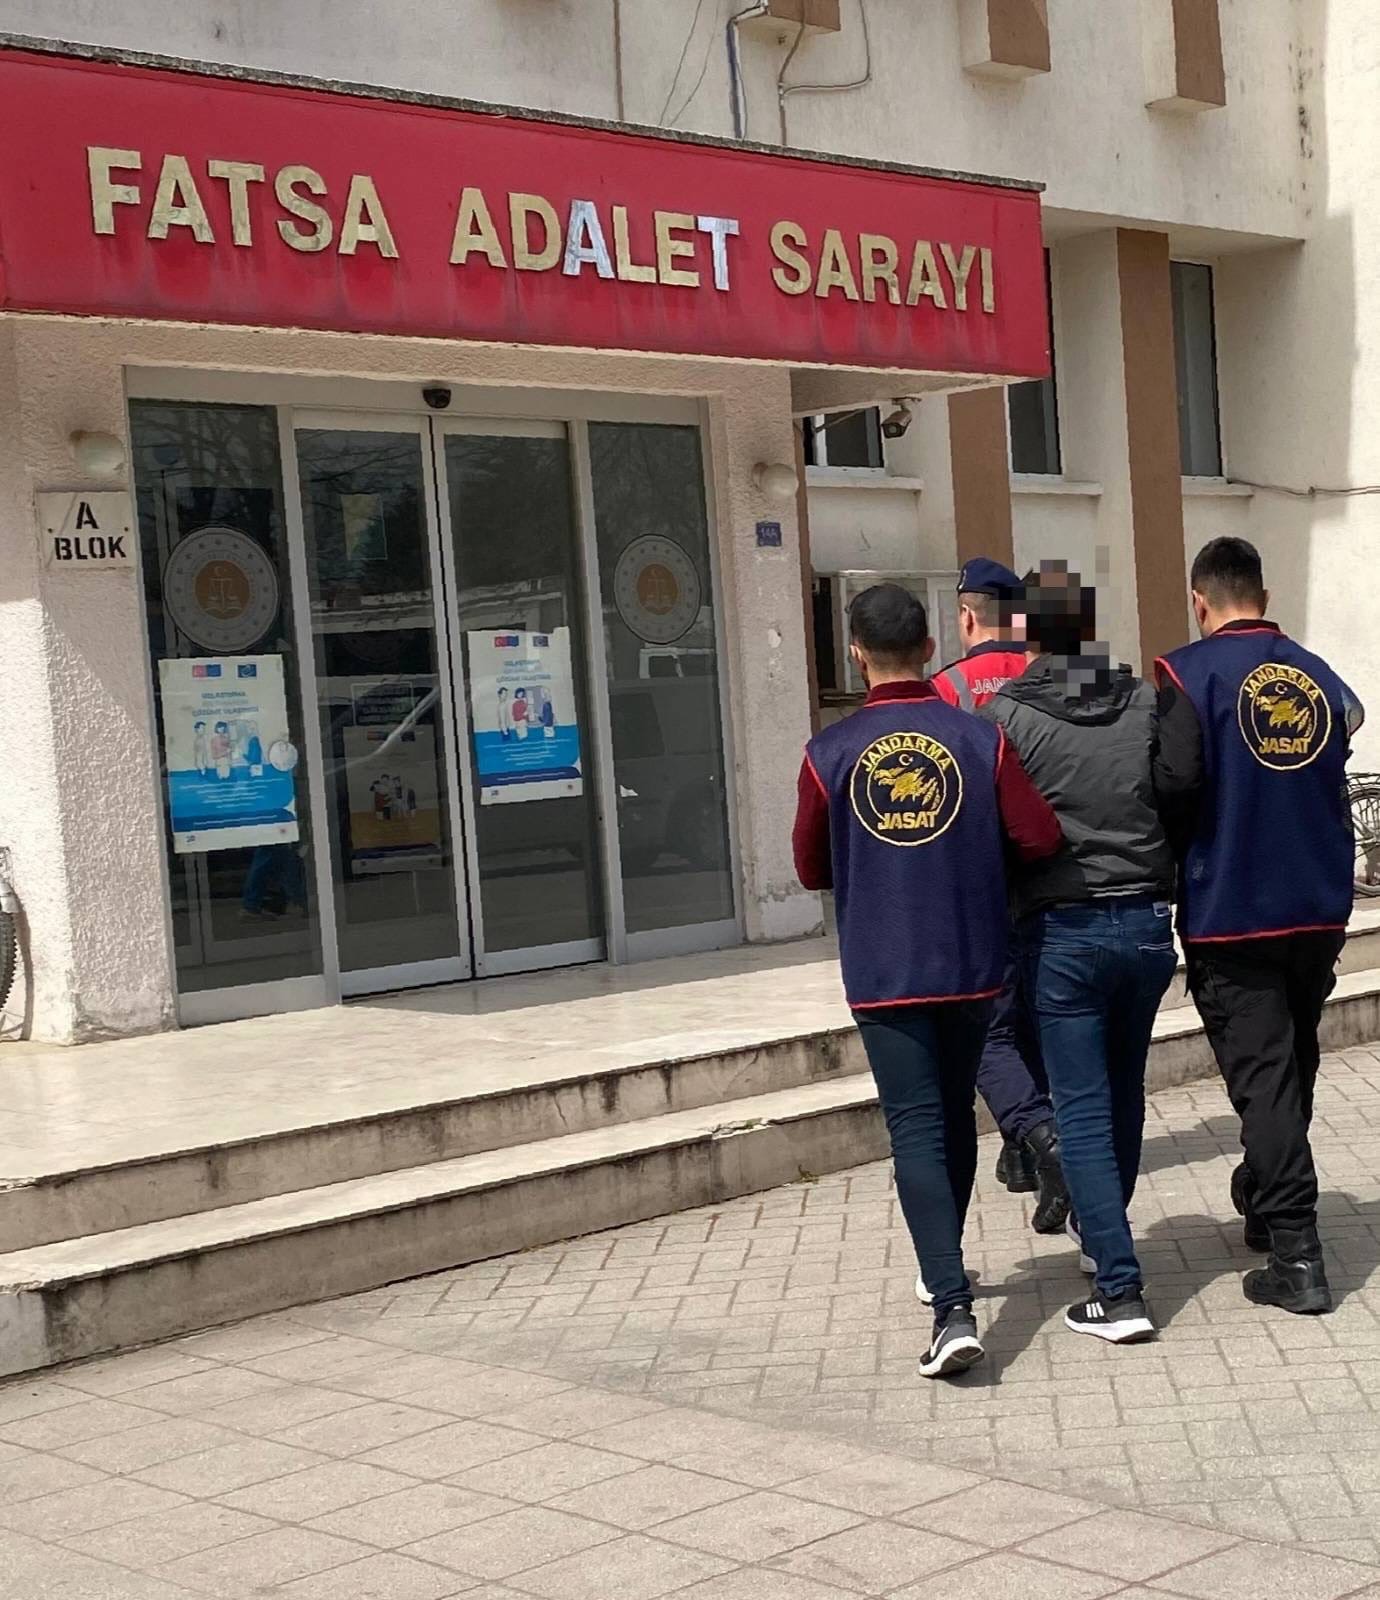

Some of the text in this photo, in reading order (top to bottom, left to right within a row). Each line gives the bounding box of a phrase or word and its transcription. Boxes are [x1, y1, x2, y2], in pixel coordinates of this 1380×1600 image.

[87, 146, 995, 313] FATSA ADALET SARAYI
[76, 502, 99, 529] A
[54, 536, 127, 560] BLOK
[1244, 667, 1320, 699] JANDARMA
[861, 736, 952, 772] JANDARMA
[1259, 737, 1311, 754] JASAT
[877, 811, 937, 830] JASAT
